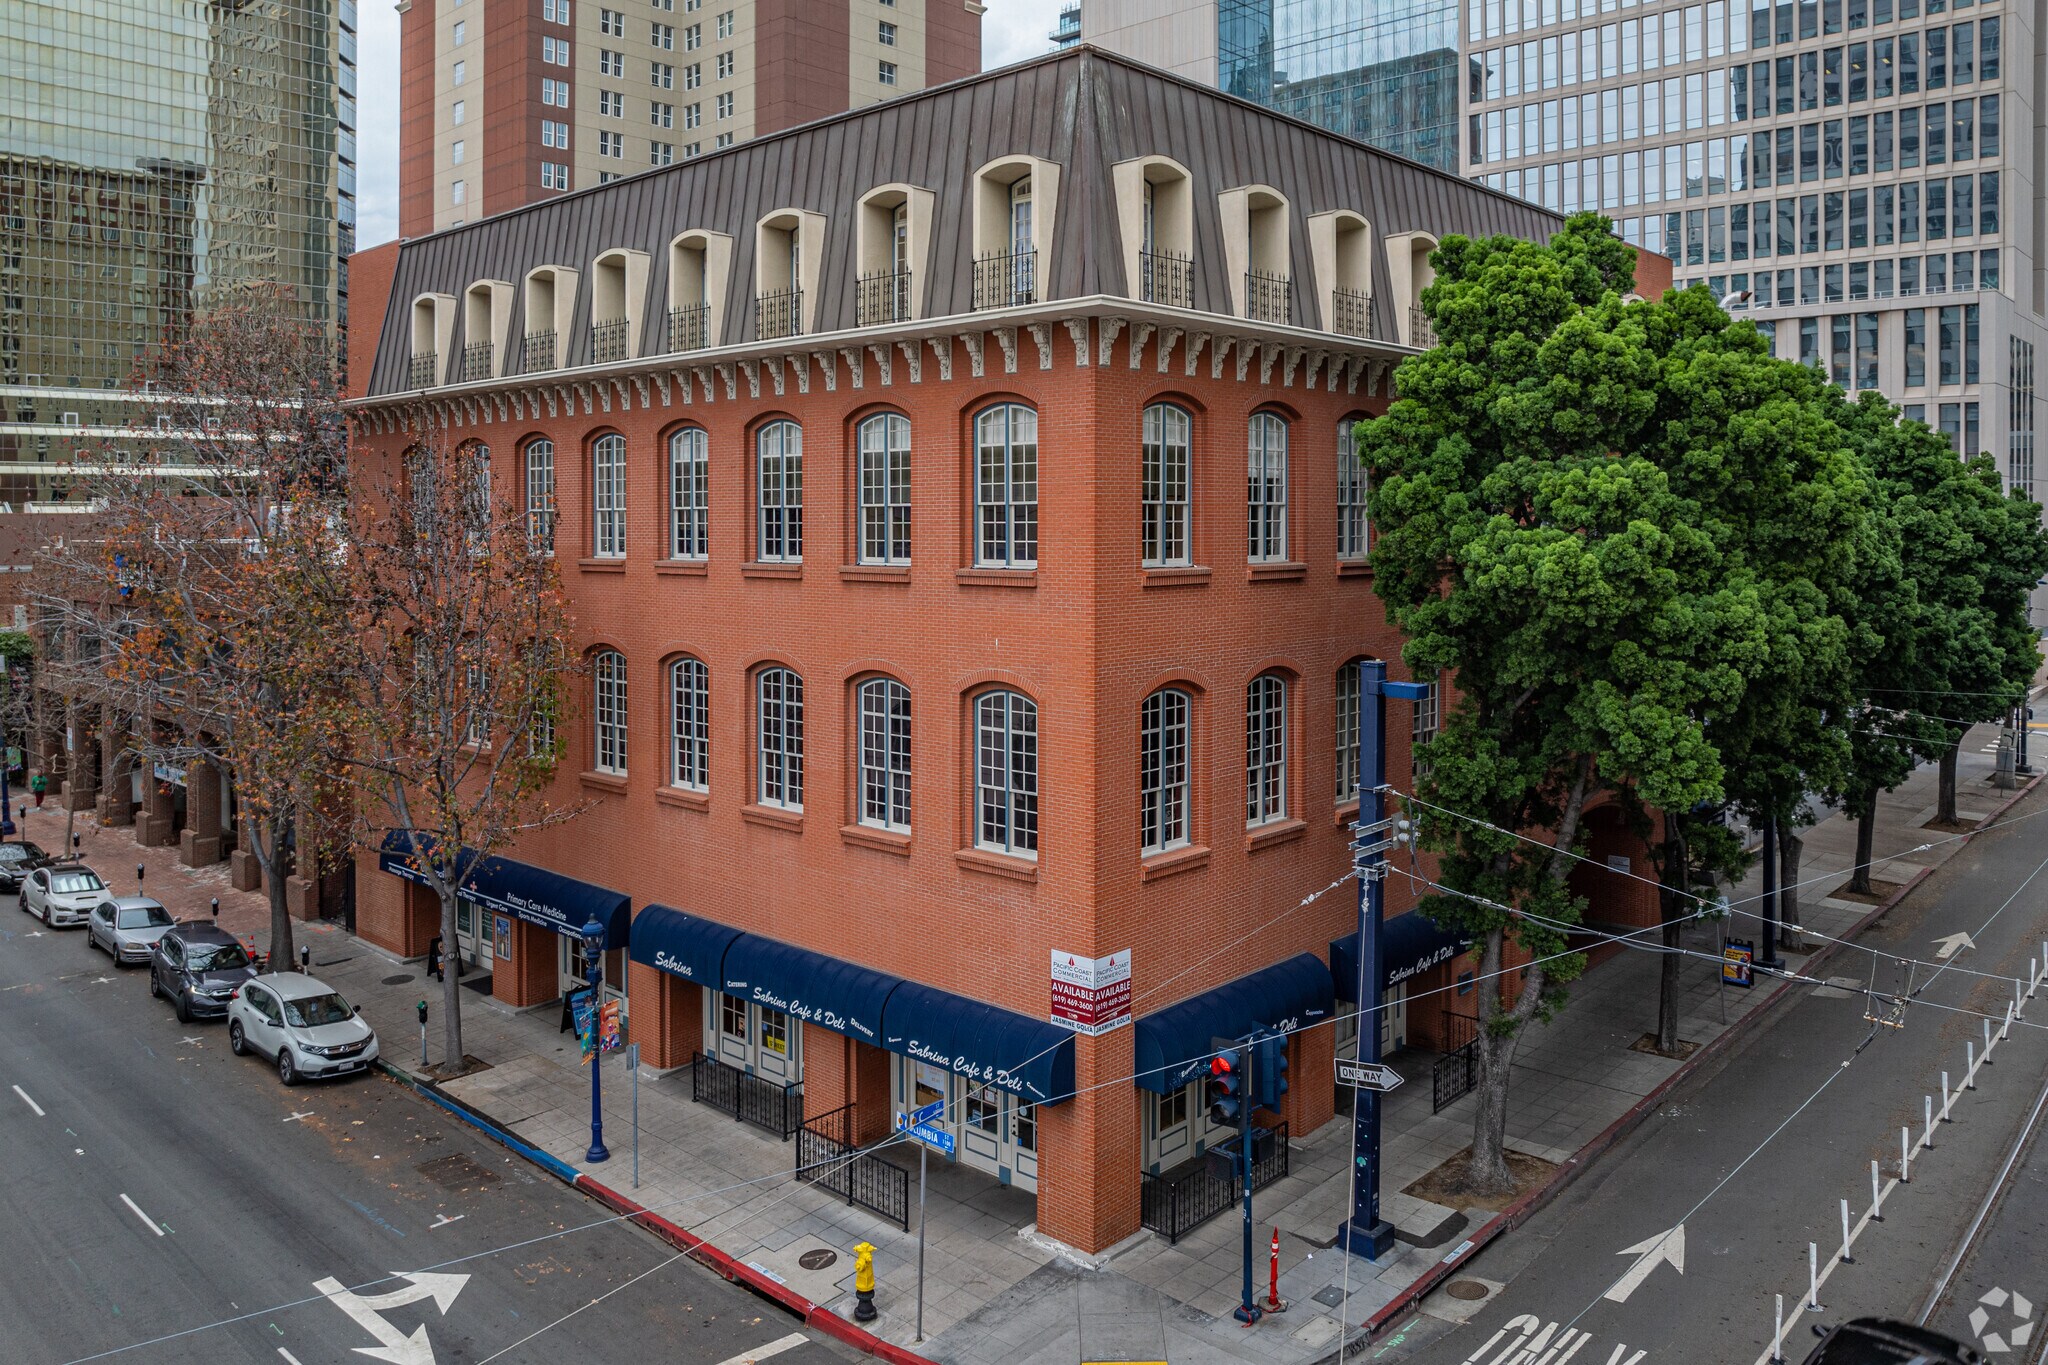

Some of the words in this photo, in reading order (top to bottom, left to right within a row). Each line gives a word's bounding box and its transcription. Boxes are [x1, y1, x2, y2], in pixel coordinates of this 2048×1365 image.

[486, 900, 499, 909] Urgent
[499, 904, 508, 913] Care
[507, 892, 527, 909] Primary
[527, 899, 542, 912] Care
[542, 904, 567, 922] Medicine
[518, 911, 530, 921] Sports
[530, 916, 548, 927] Medicine
[655, 951, 692, 976] Sabrina
[1053, 961, 1073, 972] PACIFIC
[1074, 966, 1093, 976] COAST
[1096, 966, 1114, 976] PACIFIC
[1113, 961, 1129, 971] COAST
[1388, 967, 1415, 985] Sabrina
[1416, 956, 1432, 973] Cafe
[1433, 950, 1439, 964] &
[1440, 945, 1454, 960] Deli
[1052, 968, 1092, 983] COMMERCIAL
[1096, 968, 1130, 983] COMMERCIAL
[1052, 982, 1094, 1002] AVAILABLE
[1095, 980, 1131, 1002] AVAILABLE
[753, 987, 788, 1009] Sabrina
[789, 1000, 812, 1020] Cafe
[813, 1008, 823, 1021] &
[824, 1011, 845, 1030] Deli
[1052, 994, 1067, 1005] (619)
[1067, 998, 1093, 1012] 469-3600
[1095, 1002, 1108, 1013] (619)
[1108, 993, 1130, 1007] 469-3600
[1052, 1016, 1075, 1028] JASMINE
[1096, 1020, 1116, 1033] JASMINE
[1280, 1017, 1298, 1033] Deli
[907, 1040, 950, 1066] Sabrina
[953, 1056, 980, 1078] Cafe
[983, 1066, 993, 1080] &
[996, 1069, 1022, 1091] Deli
[1342, 1067, 1360, 1079] ONE
[1363, 1071, 1381, 1082] WAY
[1462, 1314, 1647, 1365] ON
